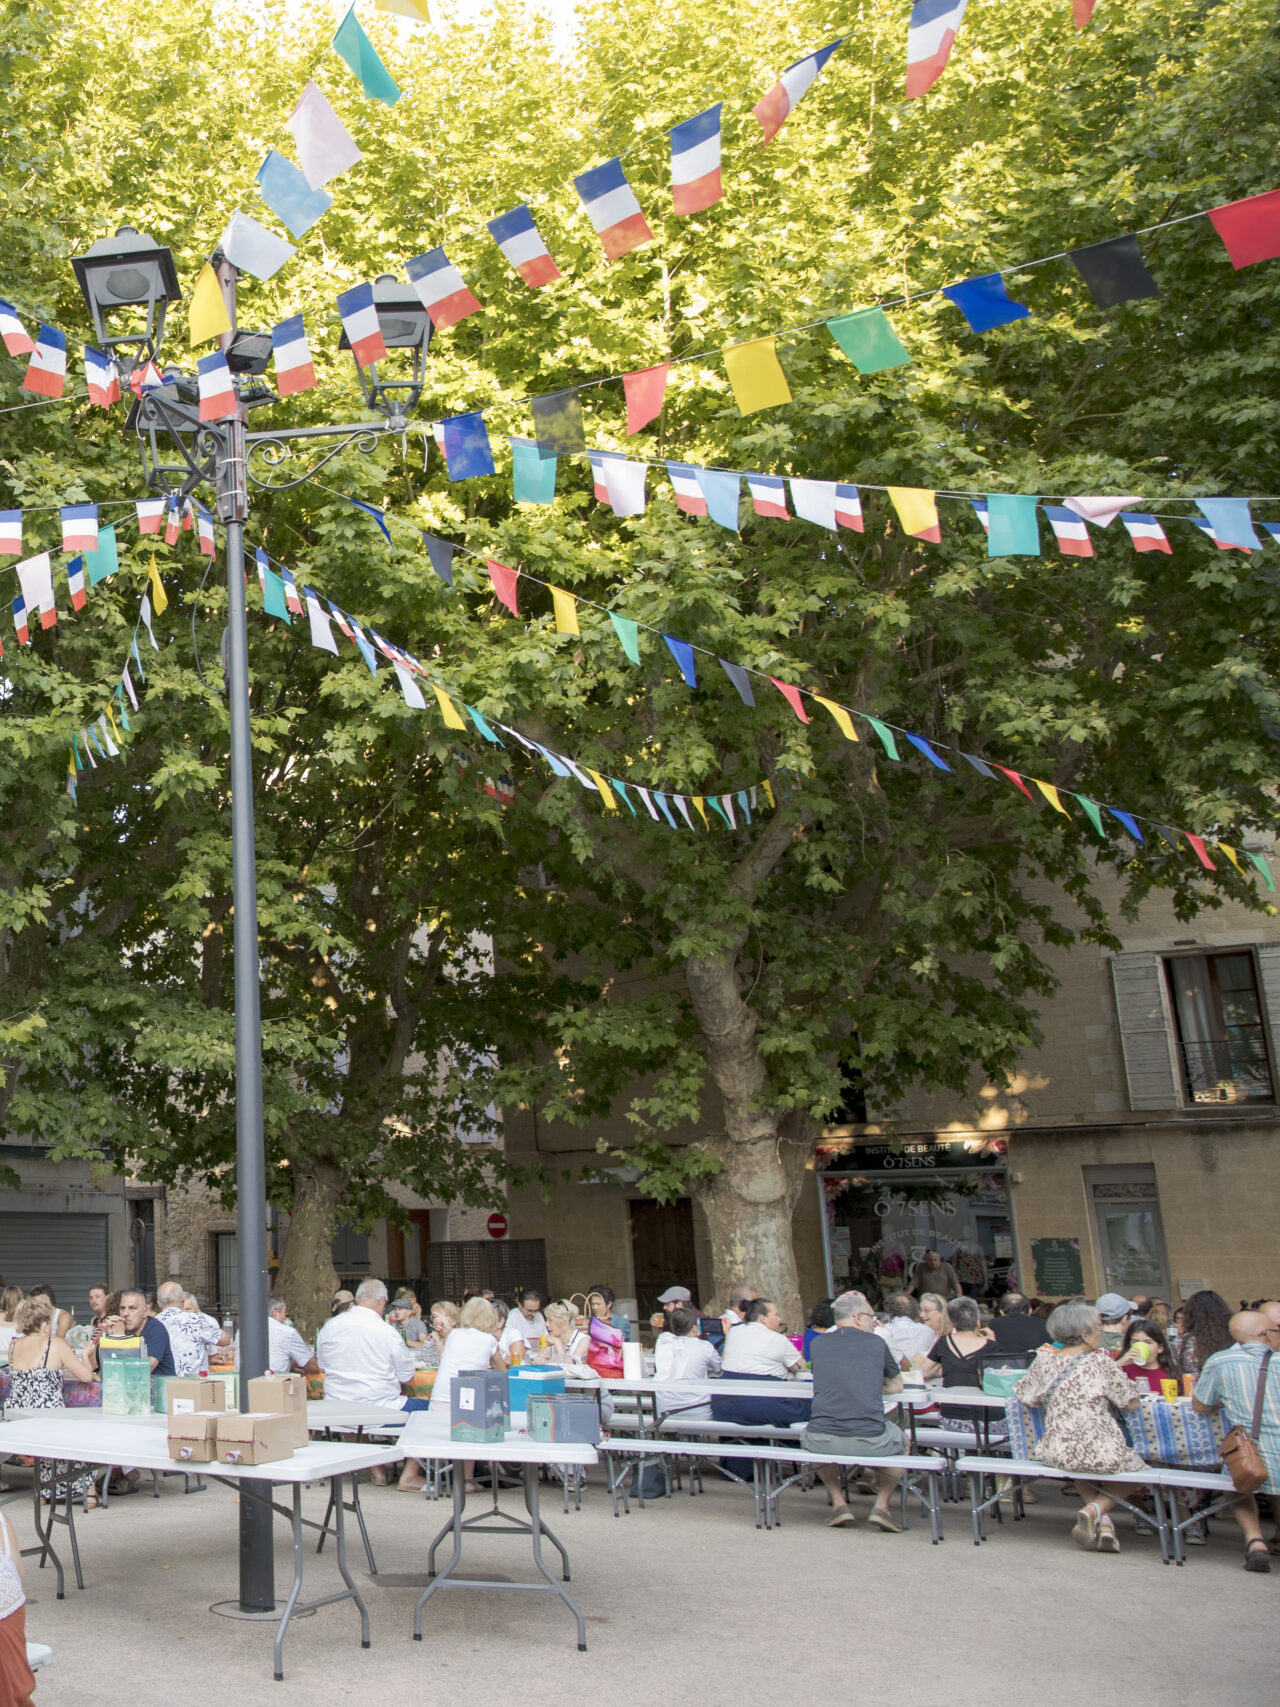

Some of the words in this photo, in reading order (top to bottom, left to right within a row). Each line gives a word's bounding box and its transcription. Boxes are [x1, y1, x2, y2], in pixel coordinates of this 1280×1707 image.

[904, 1144, 916, 1153] DE
[917, 1142, 952, 1153] BEAUTÉ
[870, 1229, 910, 1254] INSTITUT
[912, 1228, 926, 1236] DE
